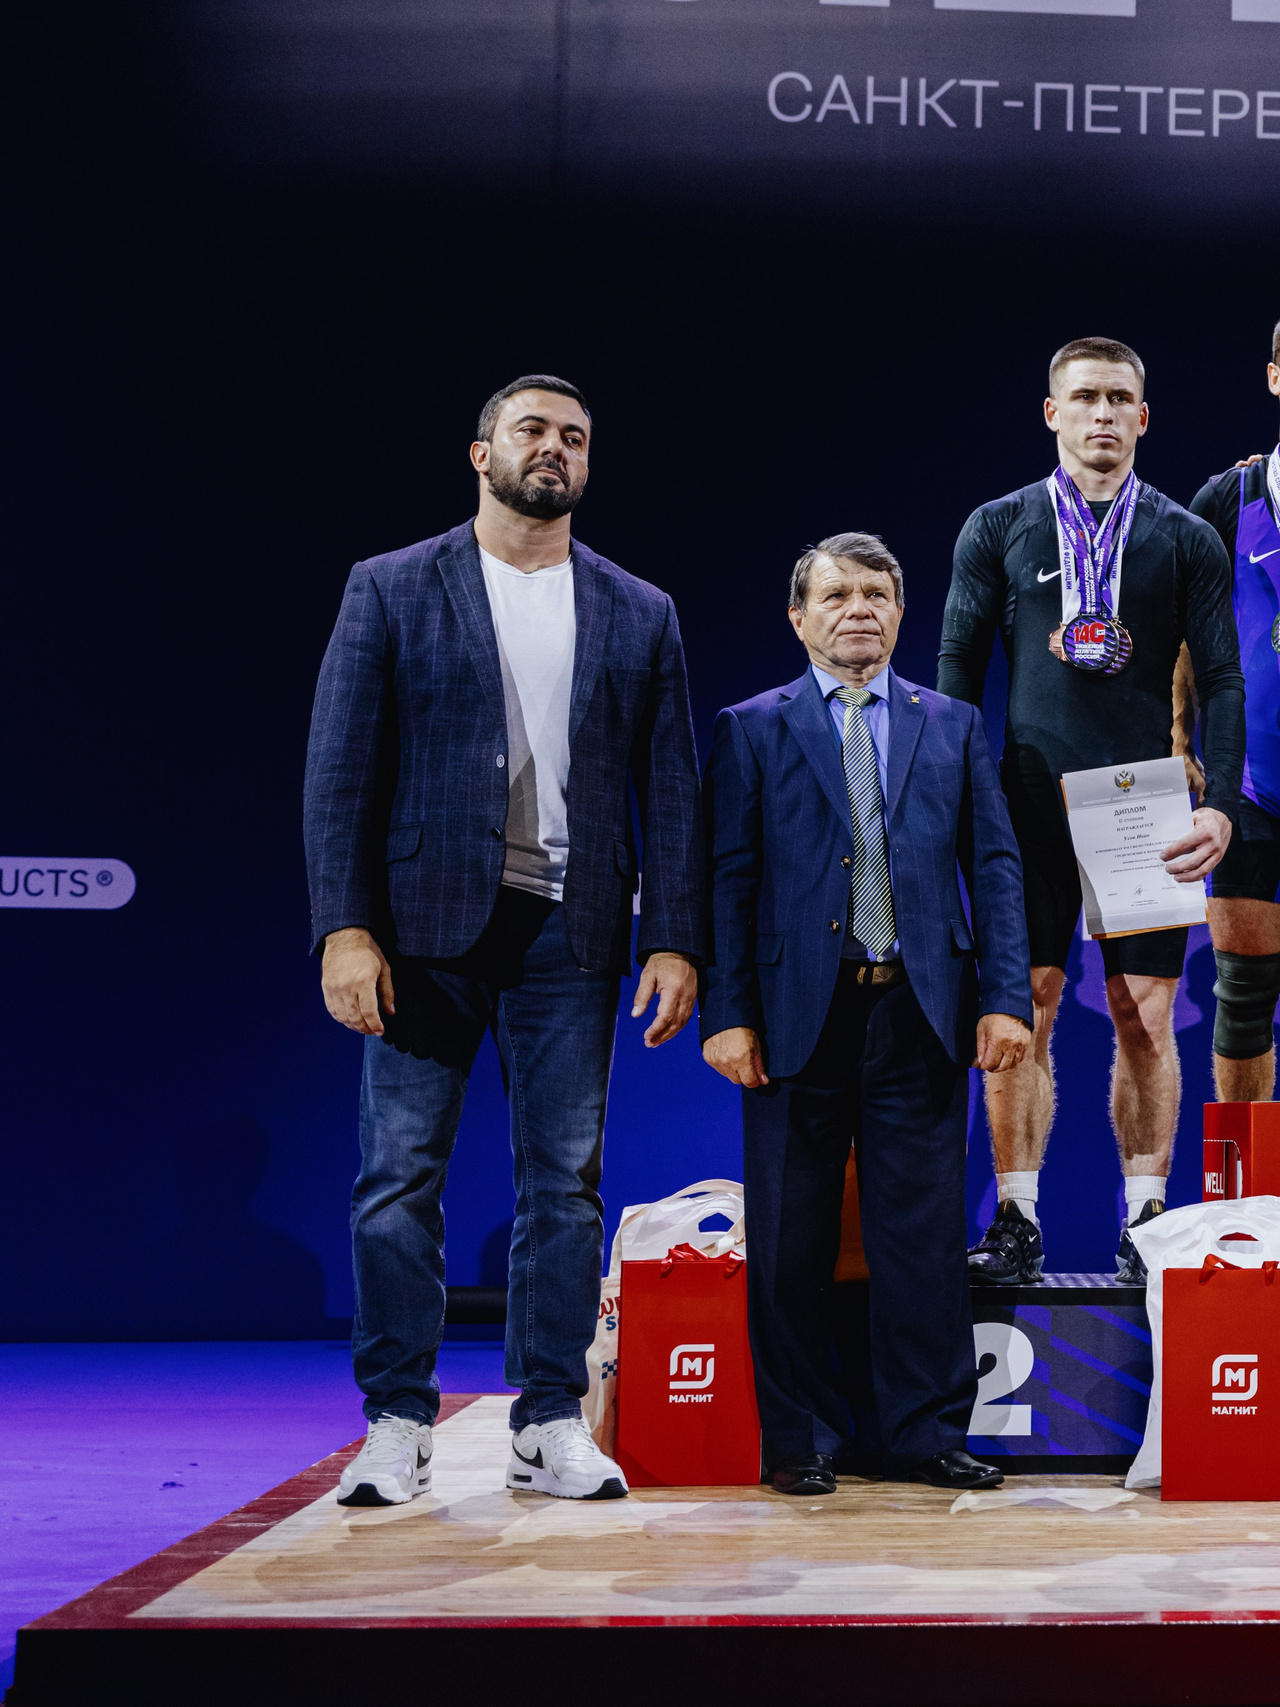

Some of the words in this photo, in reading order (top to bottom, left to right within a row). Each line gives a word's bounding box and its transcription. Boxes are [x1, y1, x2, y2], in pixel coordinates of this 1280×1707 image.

[1064, 552, 1072, 590] ФЕДЕРАЦИИ
[1114, 806, 1146, 817] ДИПЛОМ
[1205, 1172, 1224, 1194] WELL
[966, 1322, 1034, 1436] 2
[669, 1394, 713, 1403] МАГНИТ
[1212, 1406, 1258, 1415] МАГНИТ
